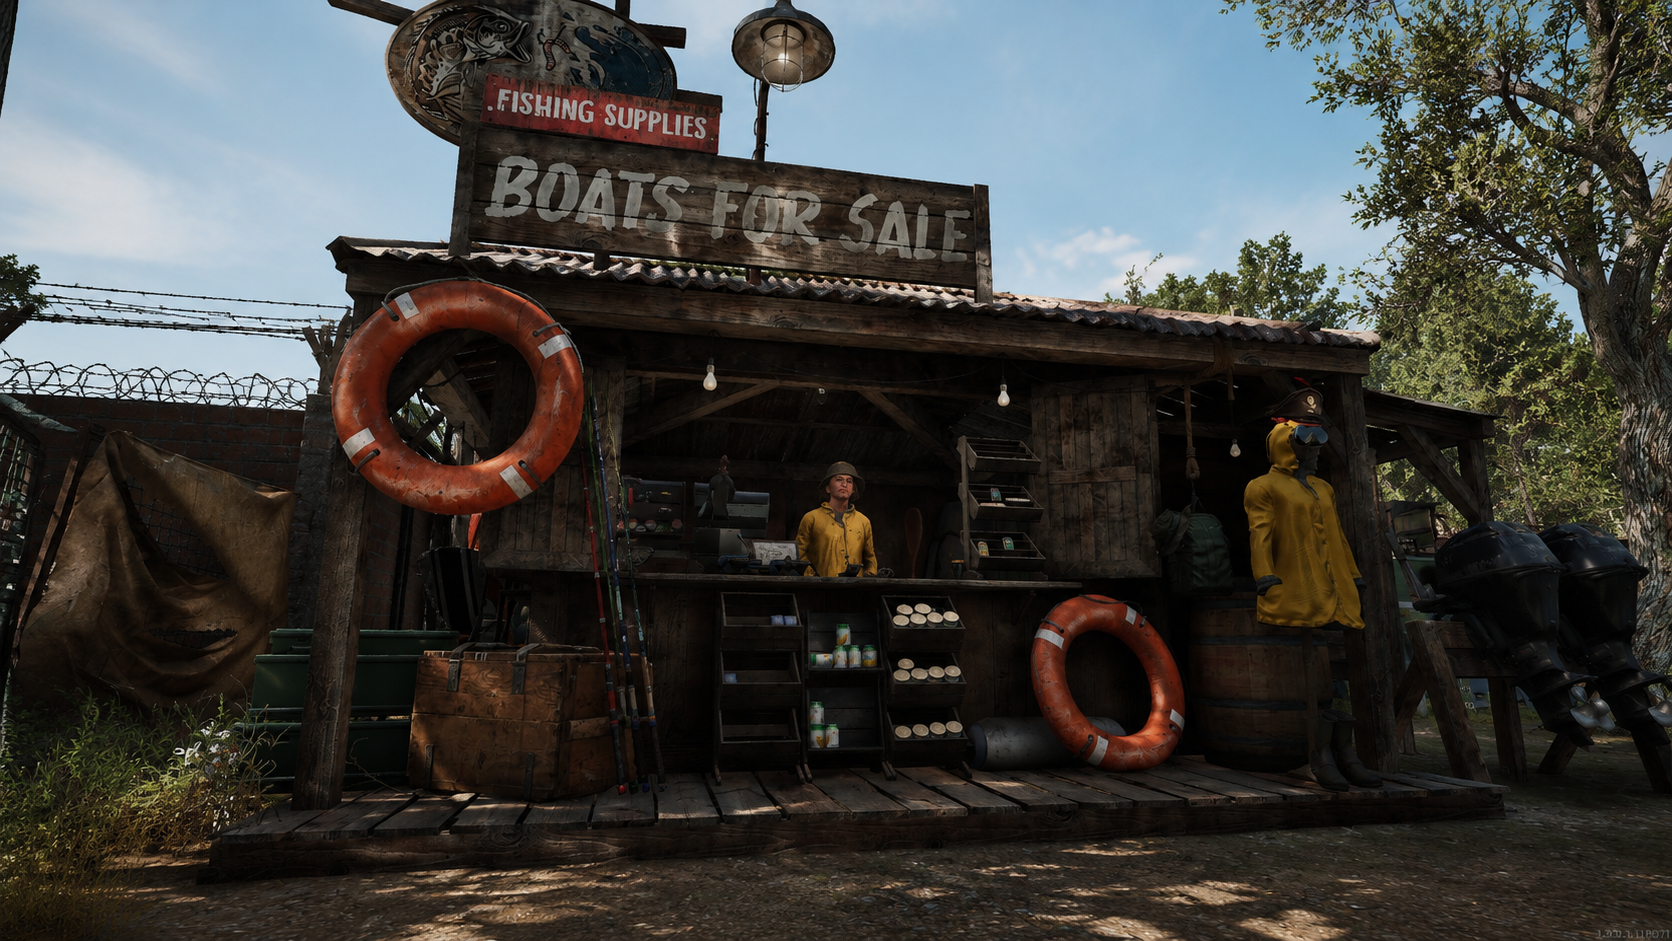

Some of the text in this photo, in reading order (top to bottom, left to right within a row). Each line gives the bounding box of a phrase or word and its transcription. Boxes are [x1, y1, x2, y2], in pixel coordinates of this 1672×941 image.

[604, 103, 707, 139] SUPPLIES
[485, 155, 971, 262] BOATS FOR SALE
